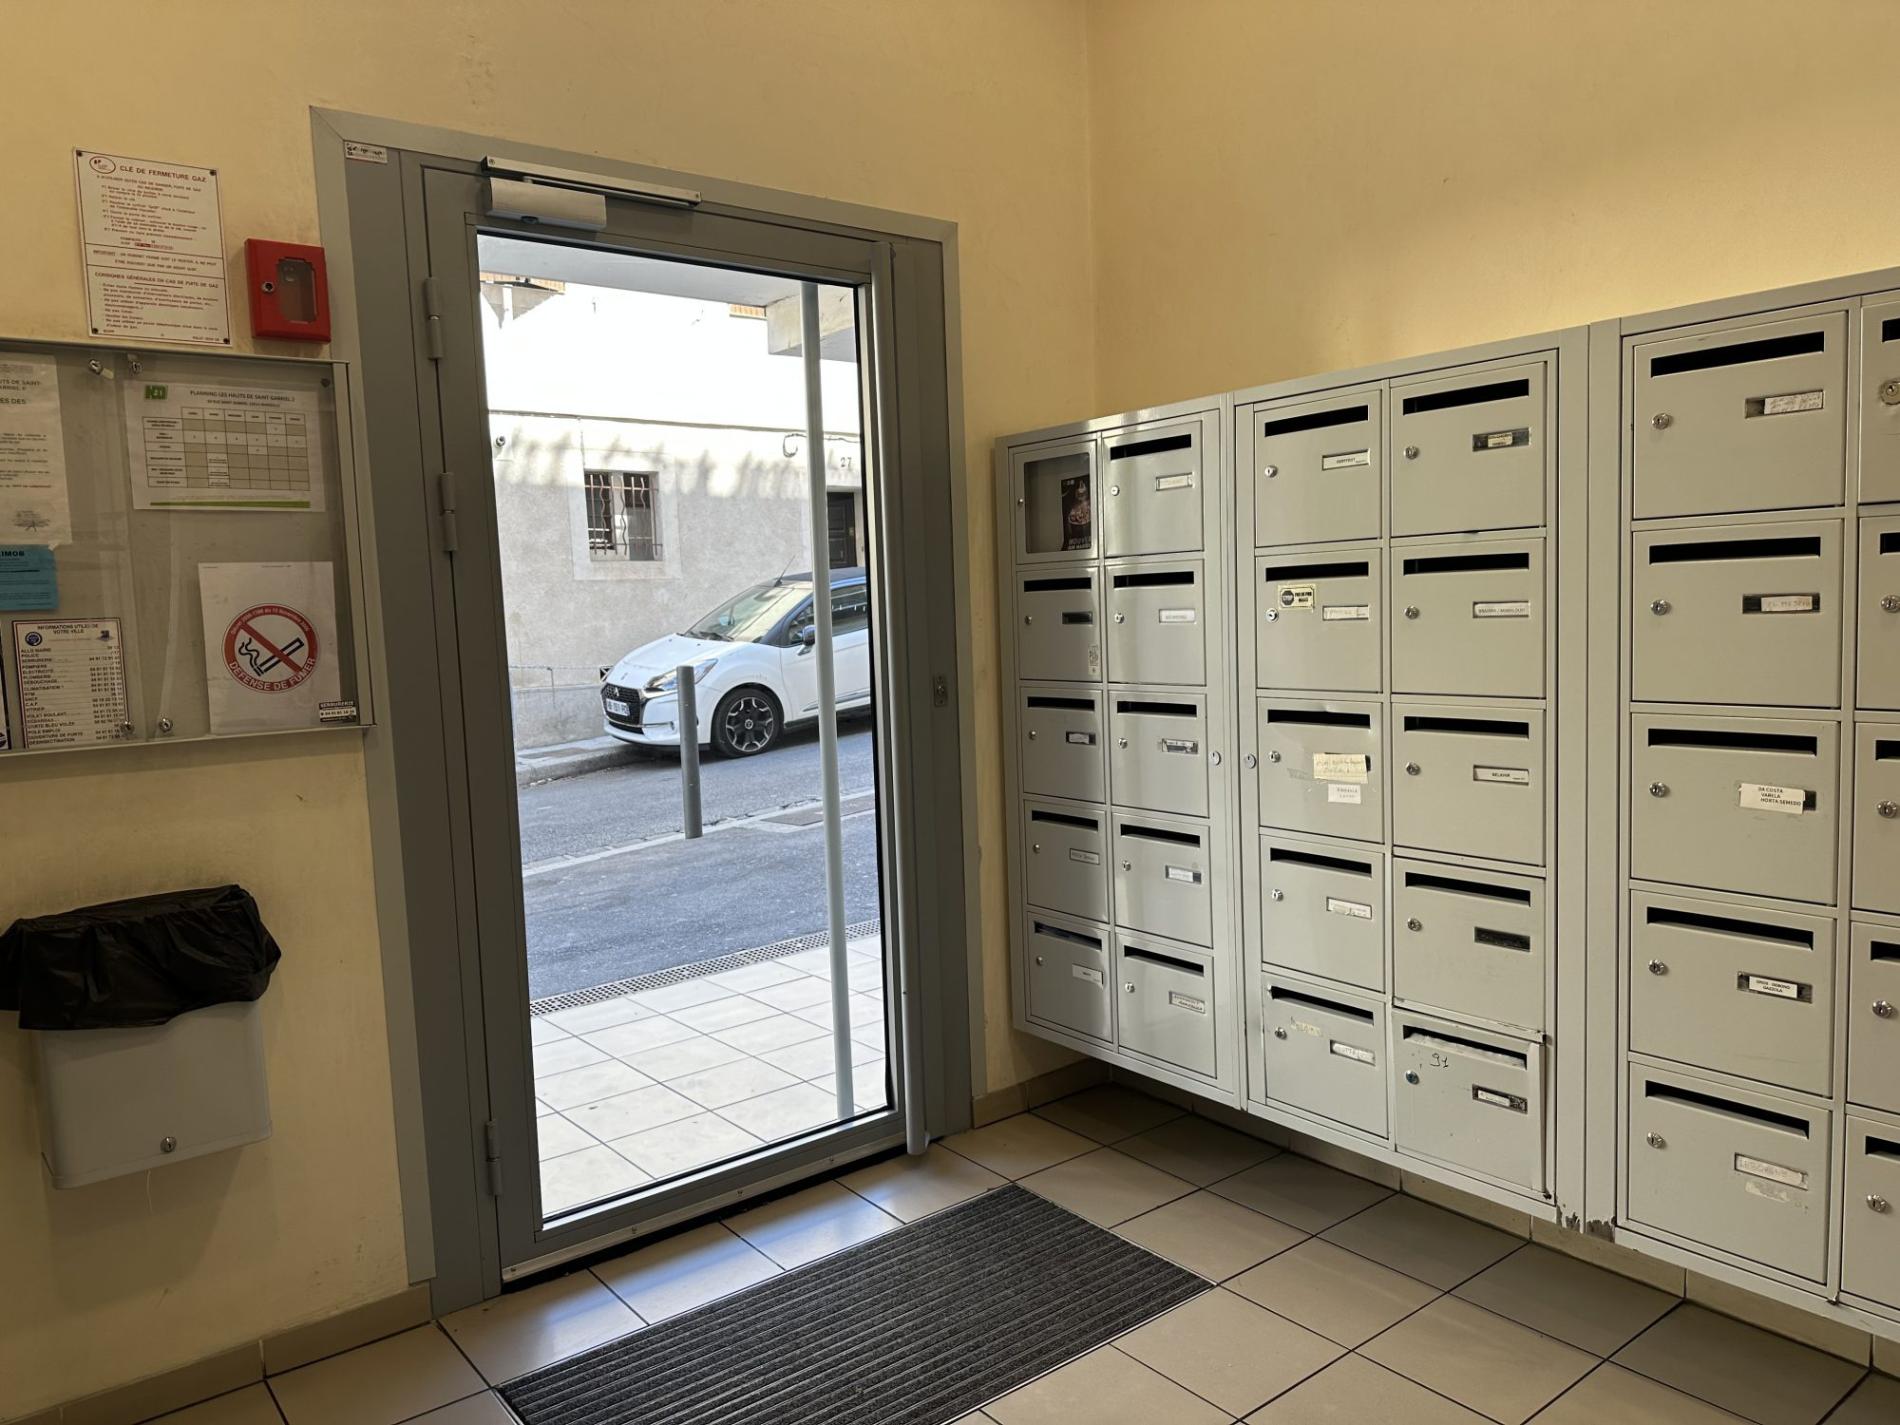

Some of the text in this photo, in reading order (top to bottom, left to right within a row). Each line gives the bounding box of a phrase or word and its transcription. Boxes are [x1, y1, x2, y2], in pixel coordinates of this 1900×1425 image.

[136, 167, 146, 175] DE
[149, 169, 189, 180] FERMETURE
[192, 175, 207, 183] GAZ
[840, 456, 852, 469] 27
[229, 657, 316, 691] DEFENSE DE FUMER
